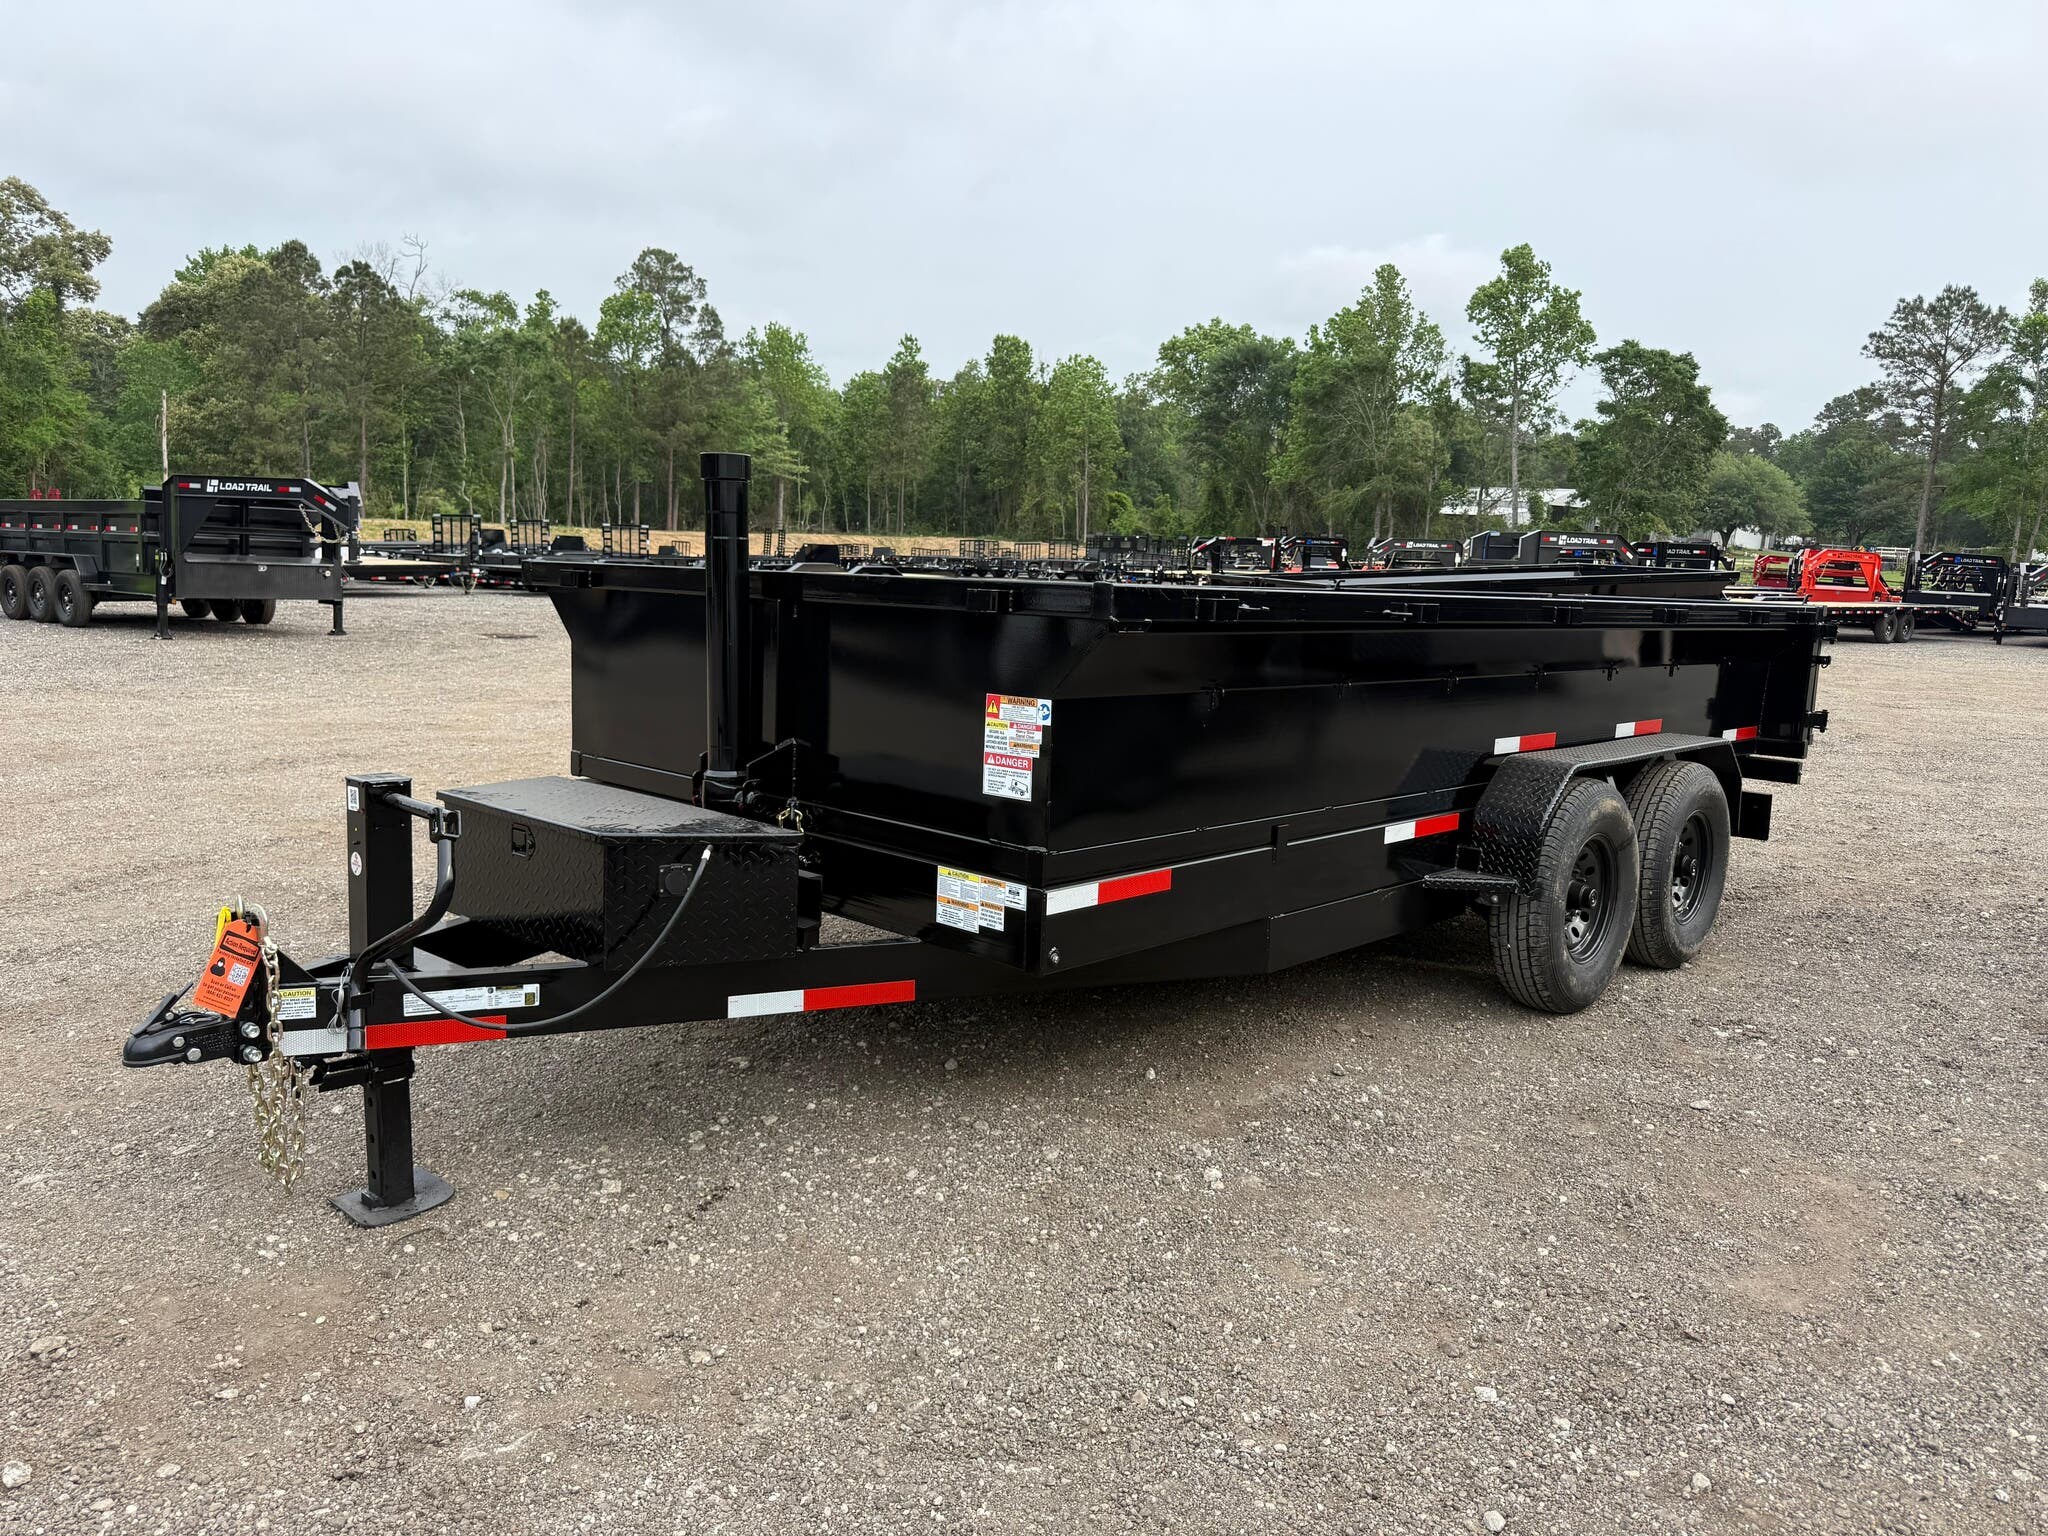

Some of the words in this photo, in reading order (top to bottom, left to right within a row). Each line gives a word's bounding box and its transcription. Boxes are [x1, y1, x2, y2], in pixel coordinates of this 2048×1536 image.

[220, 482, 245, 491] LOAD
[246, 483, 272, 492] TRAIL
[1007, 697, 1036, 706] WARNING
[995, 756, 1029, 768] DANGER
[952, 871, 969, 879] CAUTION
[225, 938, 238, 949] Action
[238, 942, 258, 956] Required
